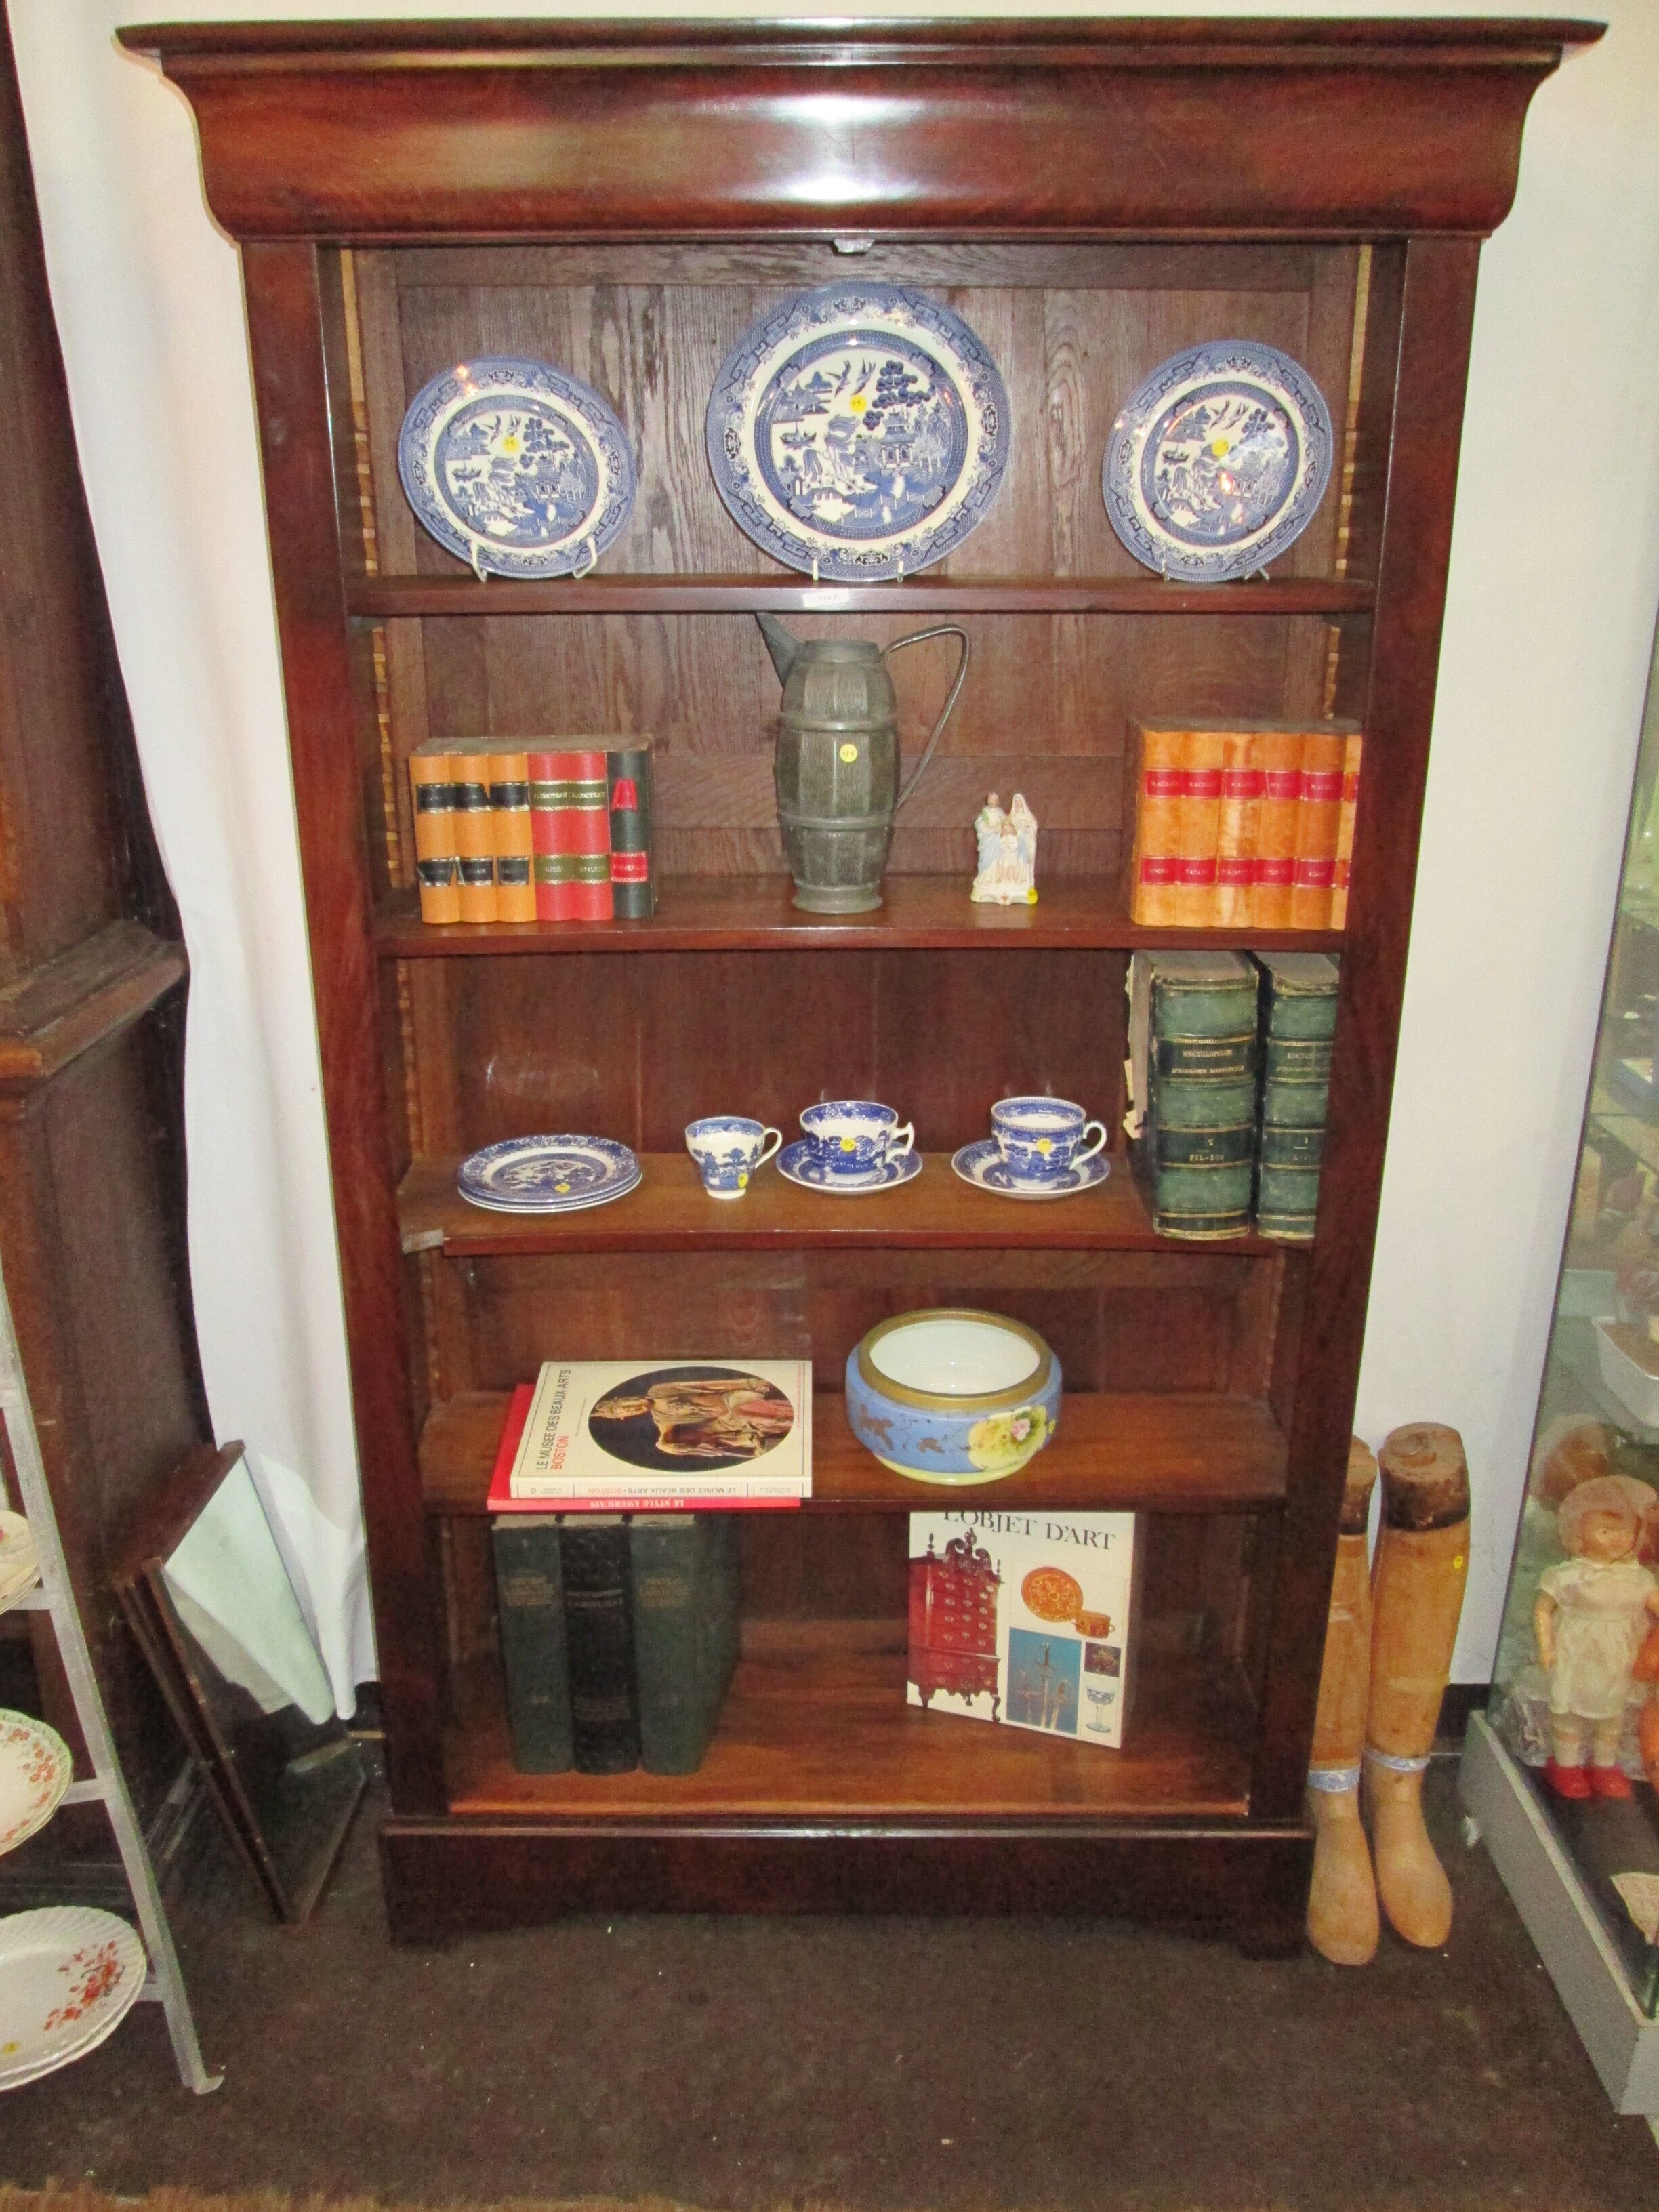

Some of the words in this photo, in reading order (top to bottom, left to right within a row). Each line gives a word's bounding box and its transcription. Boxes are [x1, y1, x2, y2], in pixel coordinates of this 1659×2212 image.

[546, 1415, 560, 1431] DES
[539, 1432, 556, 1460] MUSEE
[550, 1435, 570, 1470] BOSTON
[535, 1460, 549, 1470] LE
[643, 1498, 671, 1508] STYLE
[672, 1499, 685, 1507] LE
[1045, 1522, 1117, 1551] D'ART
